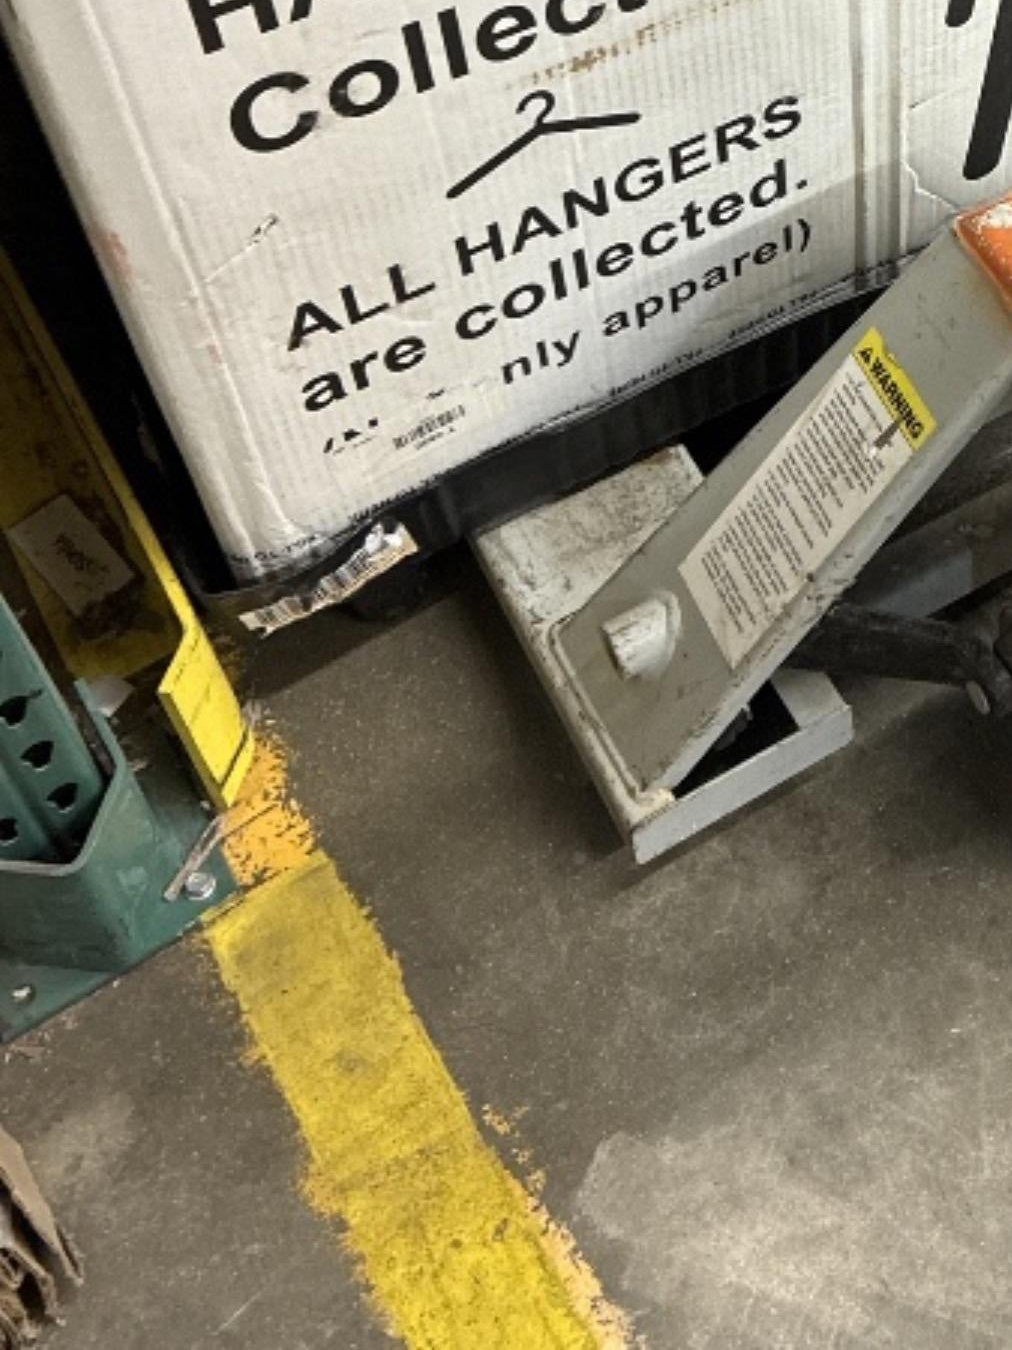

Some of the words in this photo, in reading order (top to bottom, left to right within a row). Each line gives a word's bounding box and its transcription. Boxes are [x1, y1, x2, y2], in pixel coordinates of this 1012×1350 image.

[286, 262, 436, 351] ALL
[453, 95, 803, 276] HANGERS
[301, 334, 427, 412] are
[453, 158, 810, 341] collected.
[501, 329, 580, 385] nly
[602, 217, 813, 337] apparel)
[870, 357, 926, 441] WARNING
